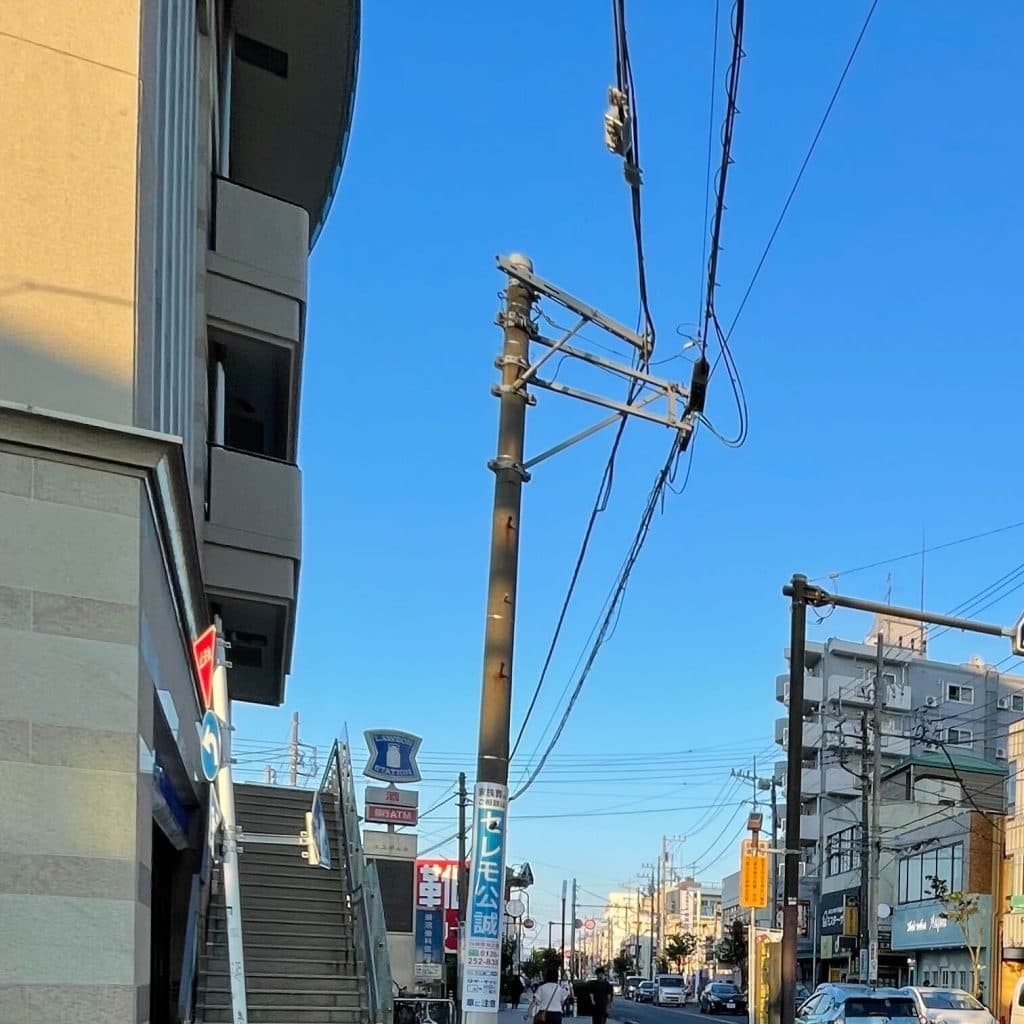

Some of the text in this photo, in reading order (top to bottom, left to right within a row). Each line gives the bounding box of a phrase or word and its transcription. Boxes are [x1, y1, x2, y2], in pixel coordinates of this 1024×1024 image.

[474, 811, 502, 936] セレモ公誠
